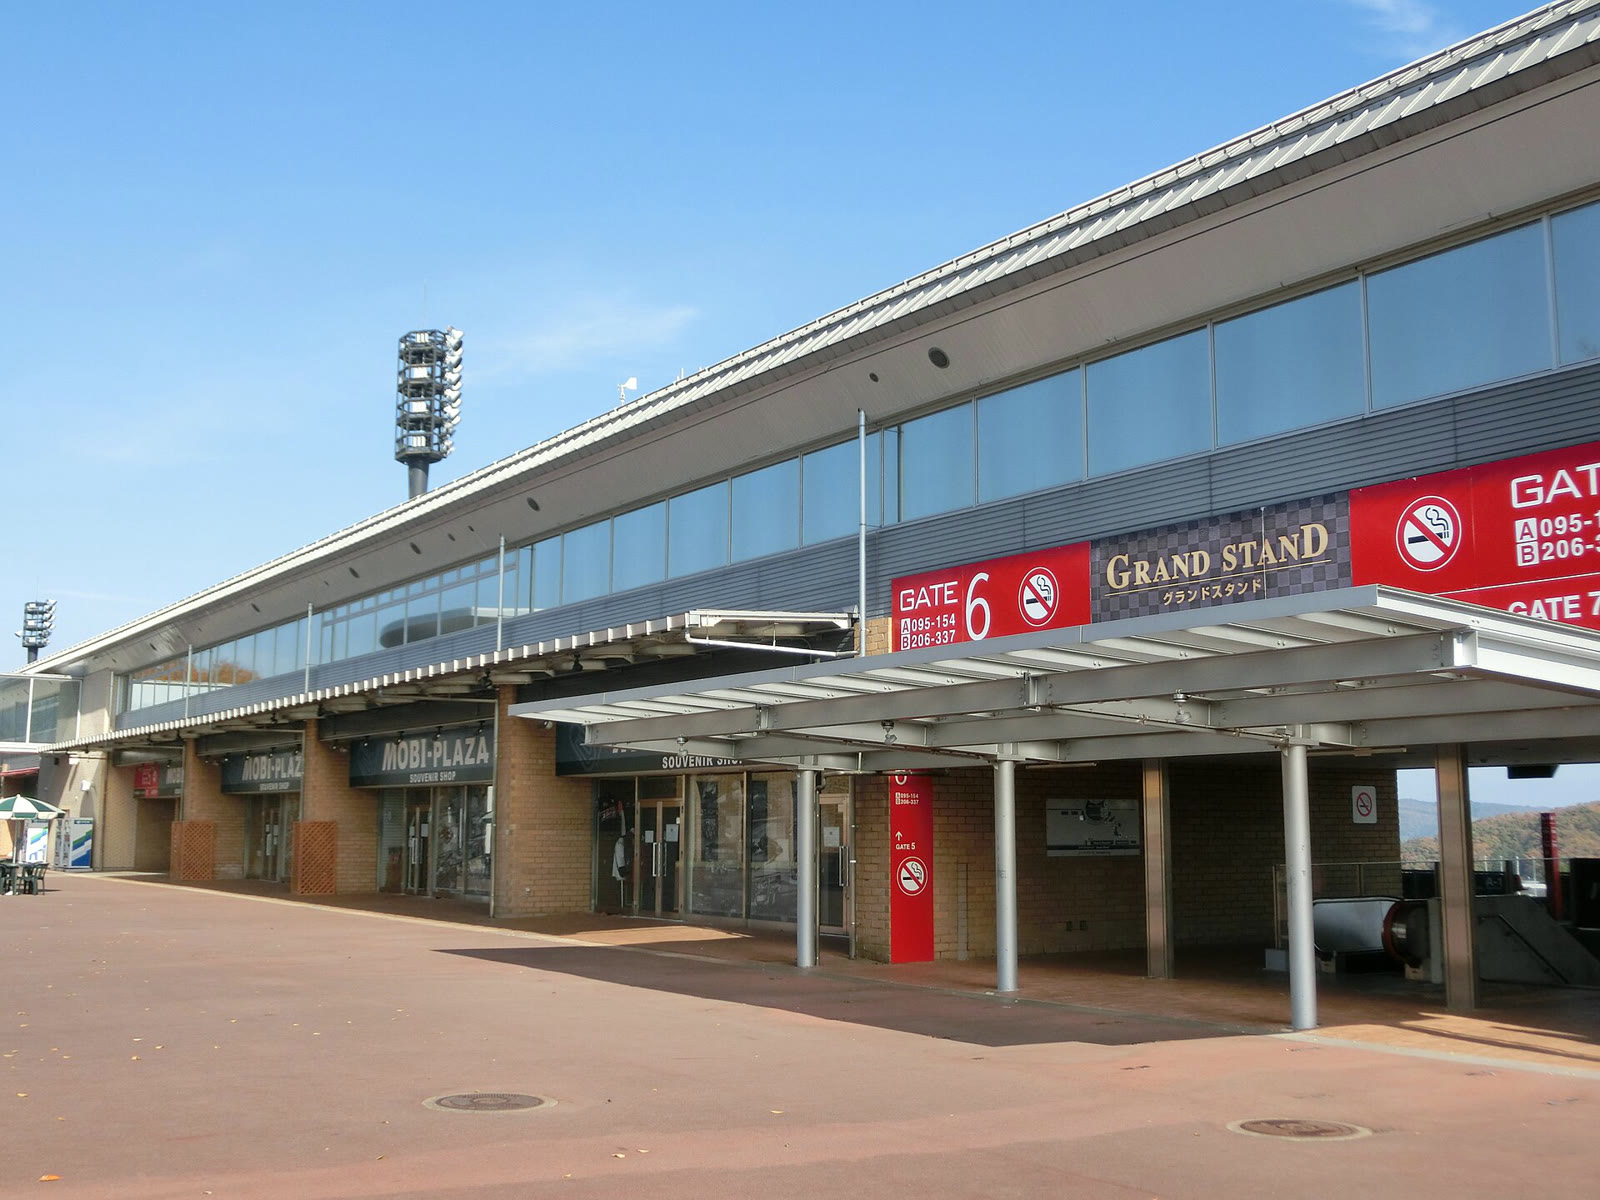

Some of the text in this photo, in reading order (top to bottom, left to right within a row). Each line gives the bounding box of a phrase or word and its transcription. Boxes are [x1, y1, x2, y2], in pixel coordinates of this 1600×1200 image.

[1518, 519, 1535, 542] A
[1106, 523, 1329, 590] GRAND STAND
[1520, 543, 1537, 566] B
[1163, 578, 1262, 606] グランドスタンド
[900, 572, 991, 641] GATE 6
[902, 613, 956, 634] A 095-154
[902, 630, 956, 650] B 206-337
[242, 756, 303, 781] MOBI-PLAZ
[662, 755, 713, 769] SOUVENIR
[409, 771, 456, 783] SOUVENIR SHOP
[911, 842, 916, 850] 5
